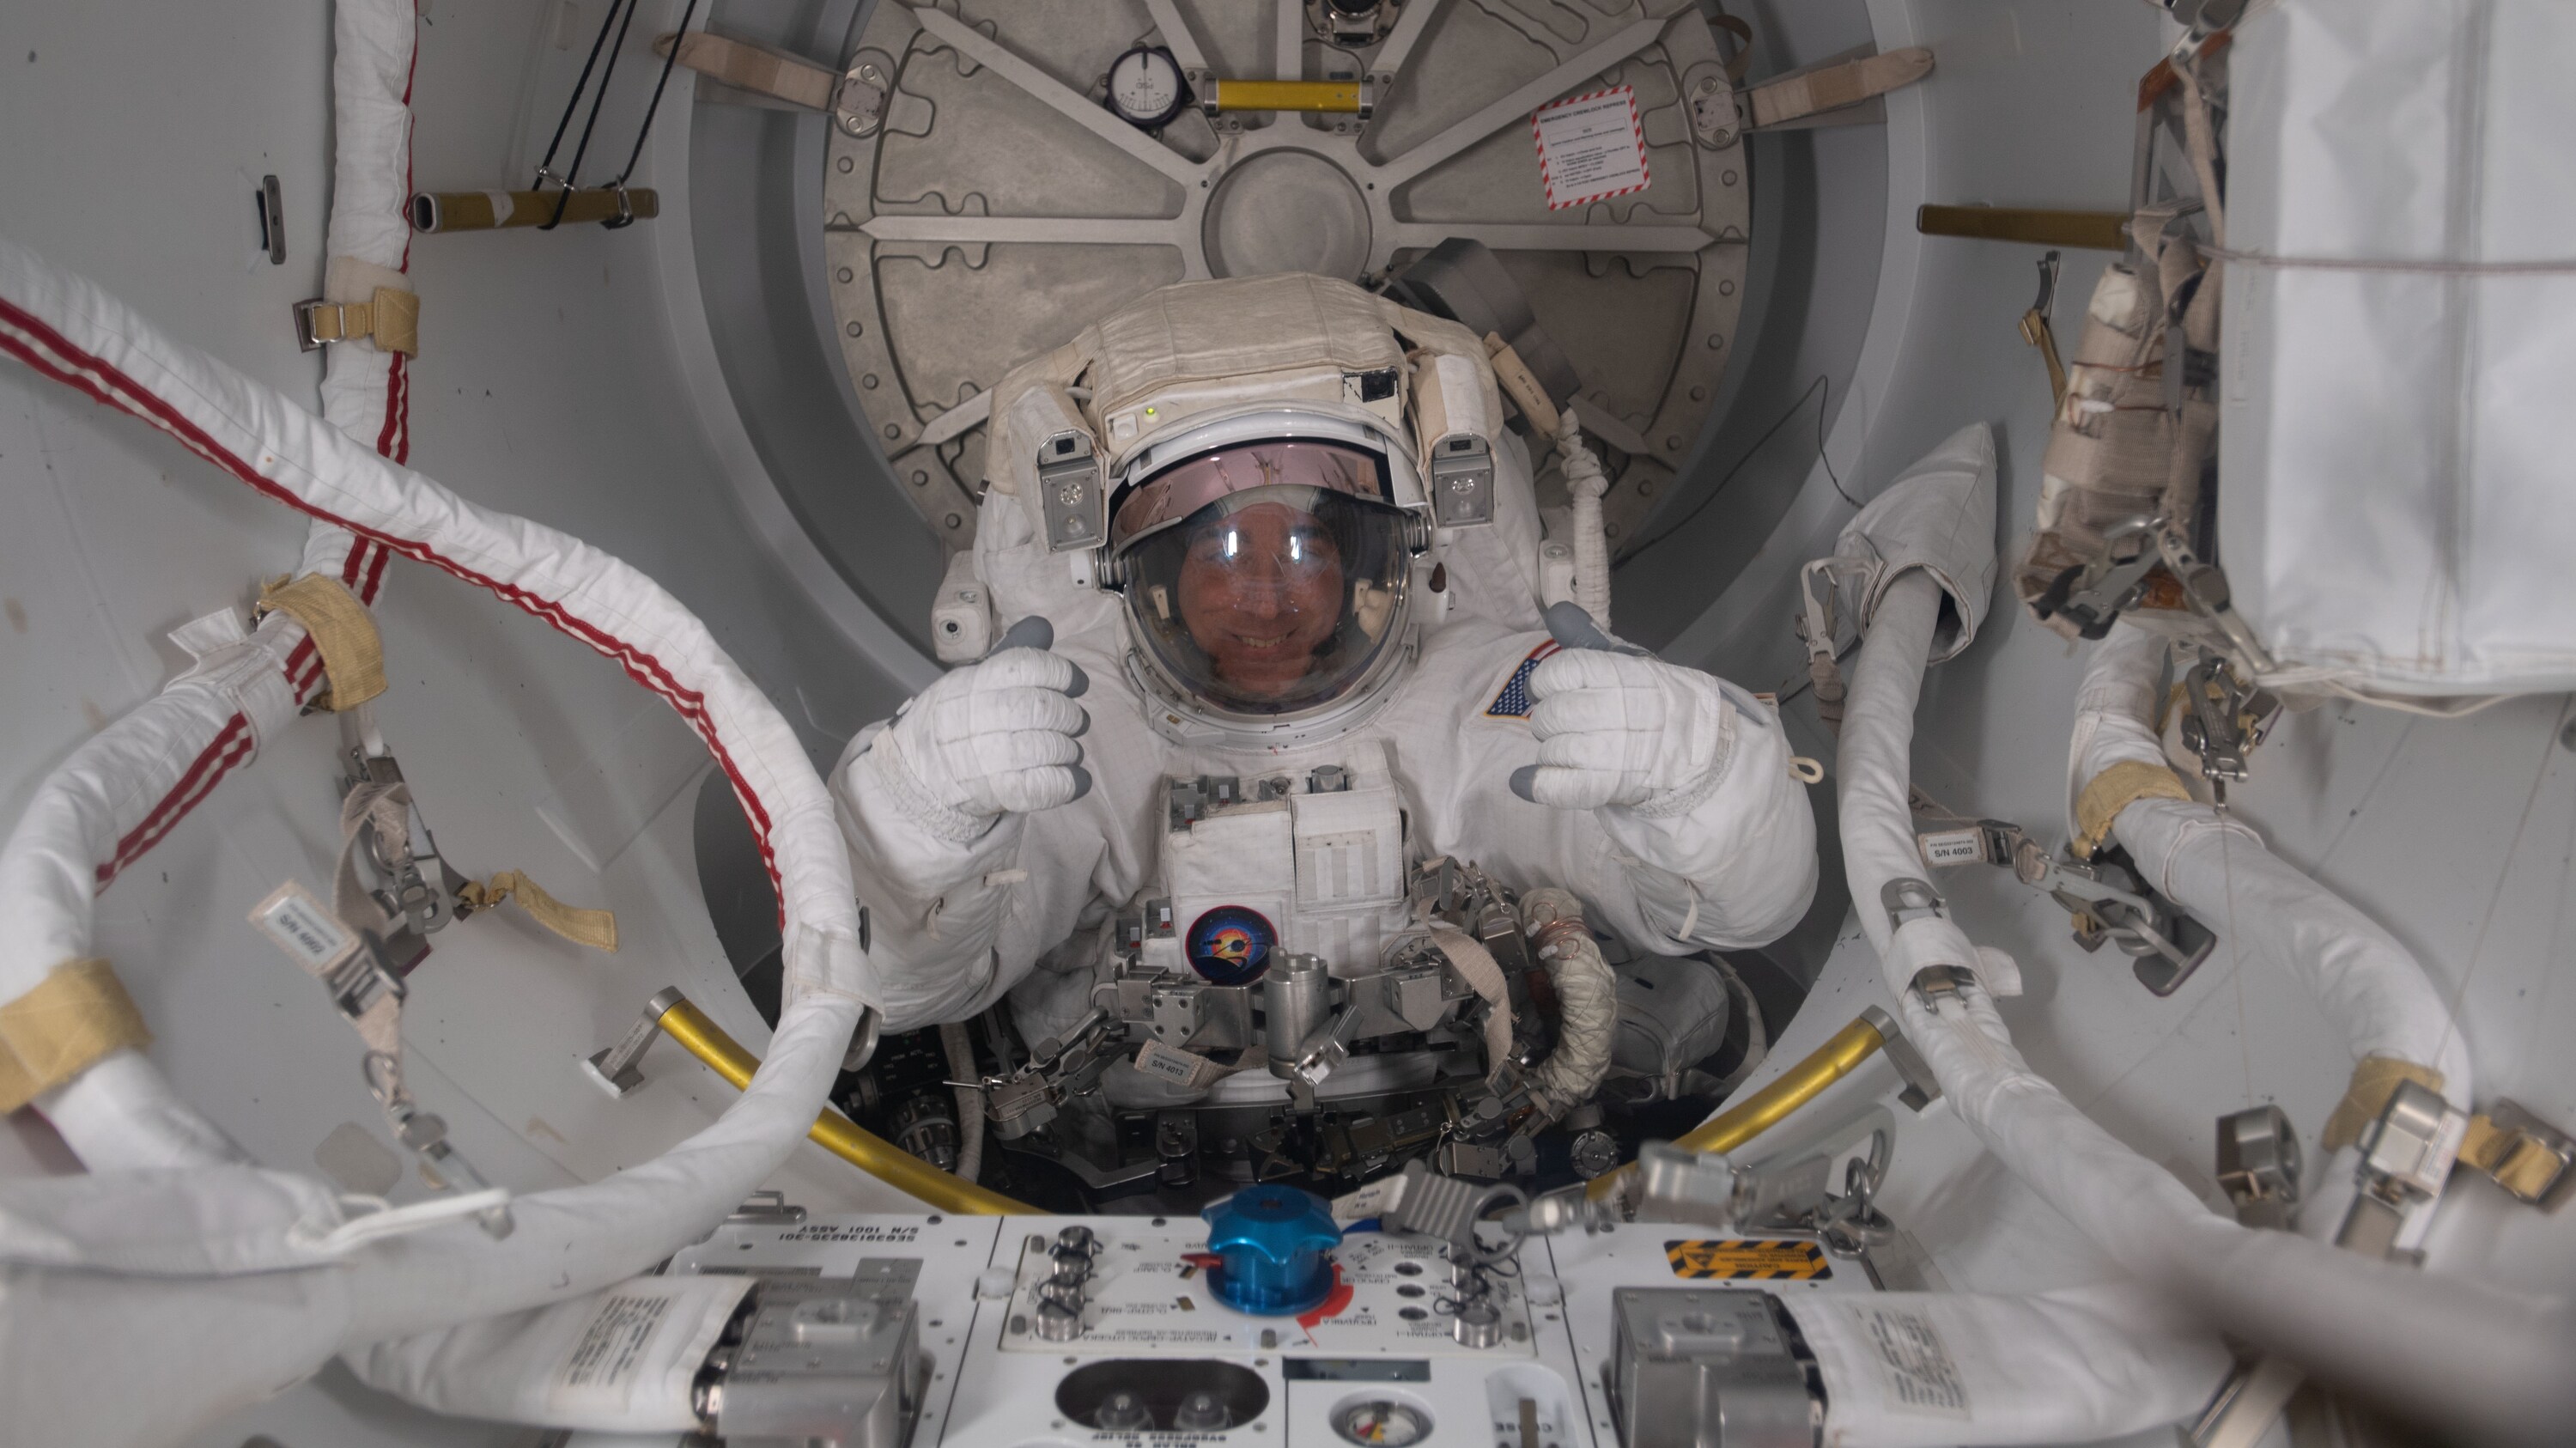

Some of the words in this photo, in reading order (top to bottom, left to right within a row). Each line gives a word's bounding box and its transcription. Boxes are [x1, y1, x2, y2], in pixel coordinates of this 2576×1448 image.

[1540, 113, 1572, 124] EMERGENCY
[1573, 106, 1601, 117] CREWLOCK
[1602, 100, 1626, 111] REPRESS
[1935, 849, 1950, 857] S/N
[1952, 847, 1973, 855] 4003
[279, 913, 299, 934] S/N
[1151, 1059, 1166, 1070] S/N
[1166, 1065, 1184, 1076] 4013
[798, 1226, 840, 1234] ASSY
